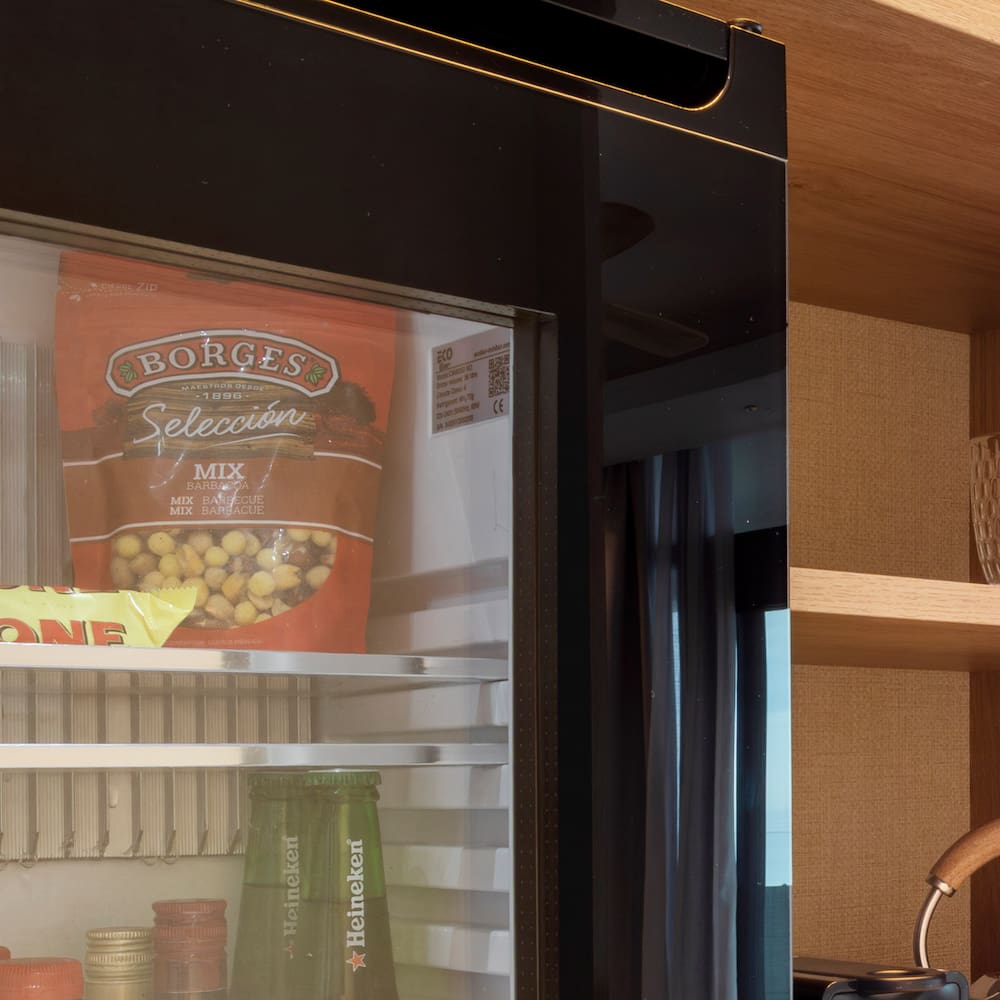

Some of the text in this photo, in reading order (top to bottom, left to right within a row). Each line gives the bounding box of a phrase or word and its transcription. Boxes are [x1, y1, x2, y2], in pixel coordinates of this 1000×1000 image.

[137, 342, 306, 376] BORGES
[133, 400, 307, 444] Selección
[193, 463, 245, 480] MIX
[186, 481, 249, 490] BARBACOA
[169, 505, 264, 516] MIX BARBACUE
[170, 495, 264, 505] MIX BARBECUE
[283, 834, 300, 937] Heineken
[346, 838, 365, 948] Heineken
